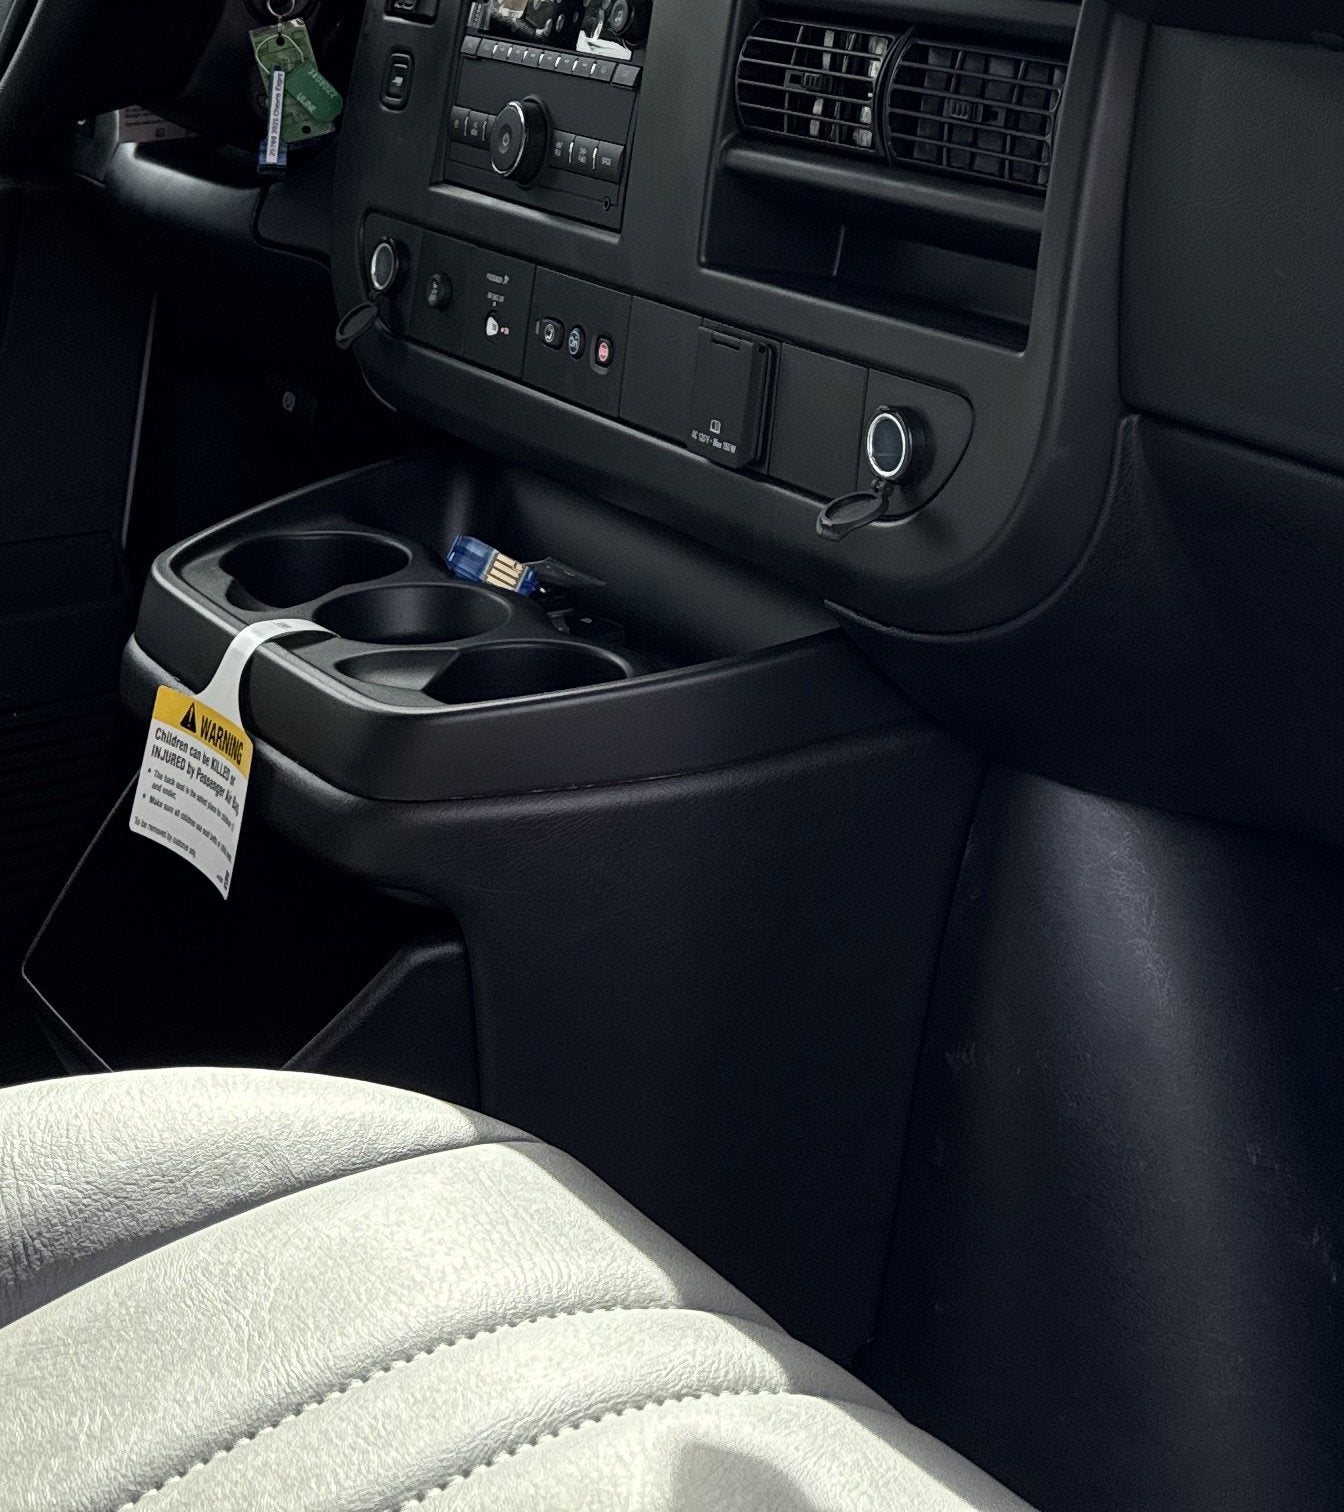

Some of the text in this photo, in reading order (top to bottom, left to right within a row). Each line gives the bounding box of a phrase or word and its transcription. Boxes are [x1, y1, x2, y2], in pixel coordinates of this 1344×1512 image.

[155, 728, 189, 754] Children
[190, 746, 202, 761] can
[202, 752, 210, 767] be
[211, 757, 231, 782] KILLED
[201, 715, 244, 766] WARNING
[151, 744, 187, 771] INJURED
[187, 761, 196, 780] by
[196, 767, 226, 798] Passenger
